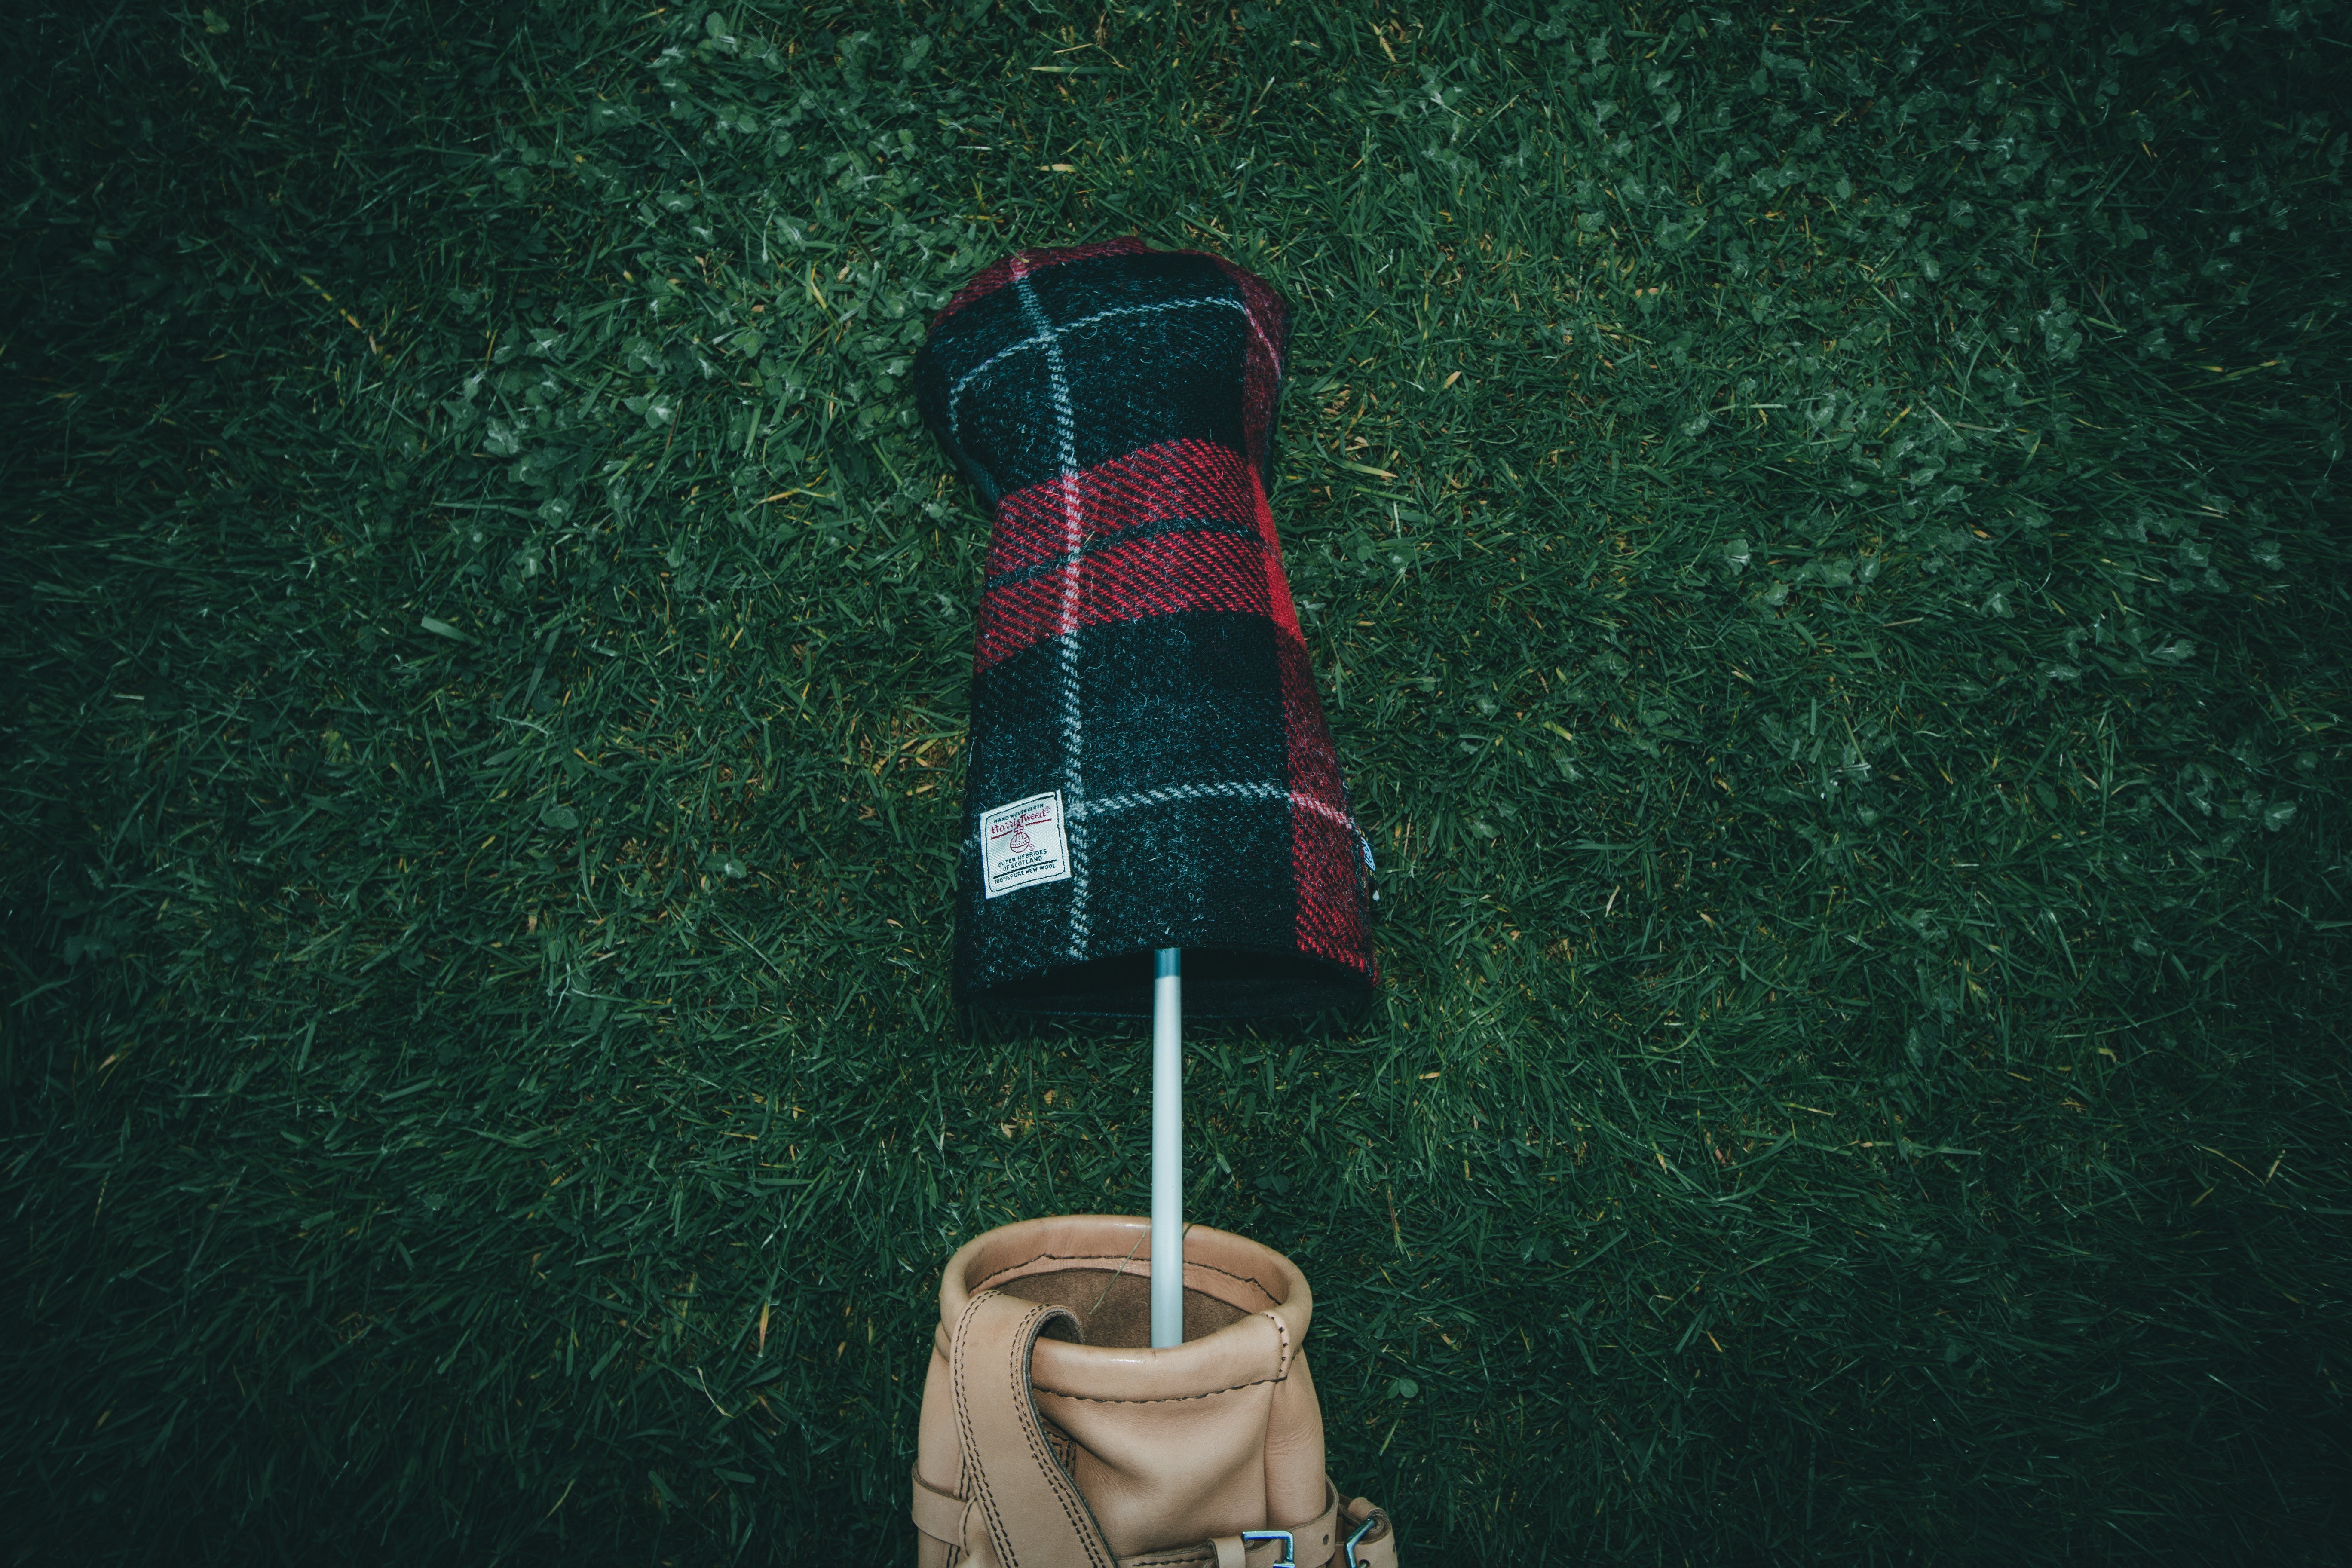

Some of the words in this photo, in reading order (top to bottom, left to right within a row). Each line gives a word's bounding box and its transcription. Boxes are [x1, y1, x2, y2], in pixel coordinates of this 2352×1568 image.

[1010, 809, 1026, 818] WOVEN
[991, 818, 1020, 834] Harris
[998, 857, 1016, 867] OUTER
[1017, 849, 1047, 861] HEBRIDES
[1011, 856, 1042, 868] SCOTLAND
[995, 875, 1010, 884] 100%
